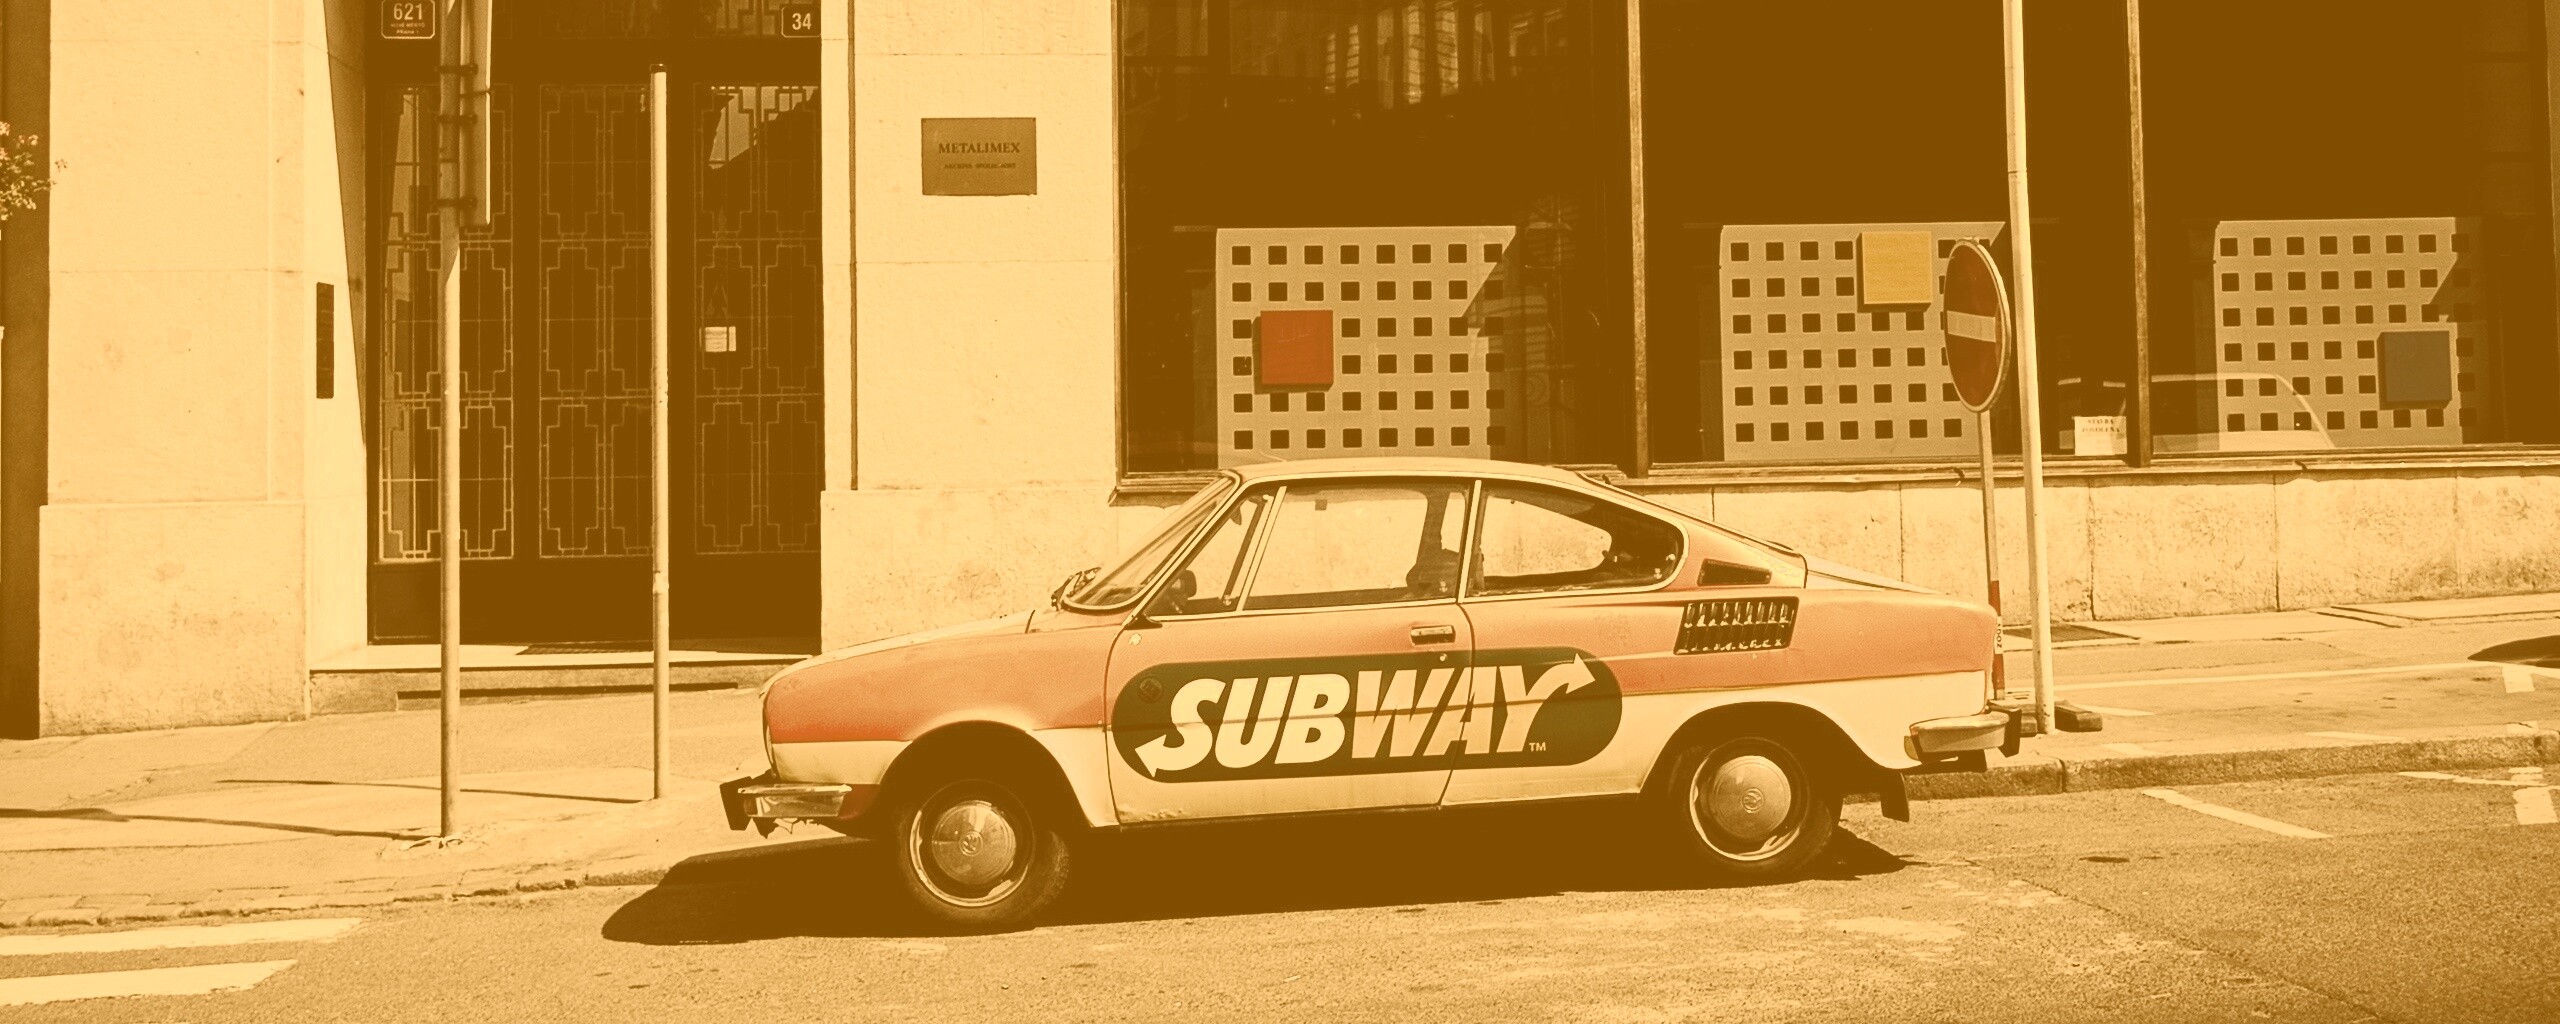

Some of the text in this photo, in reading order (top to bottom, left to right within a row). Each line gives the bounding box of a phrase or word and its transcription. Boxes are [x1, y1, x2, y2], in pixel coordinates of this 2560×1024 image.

[393, 2, 423, 20] 621
[792, 12, 811, 30] 34
[938, 142, 1020, 154] METALIMEX
[1134, 653, 1595, 778] SUBWAY
[1529, 741, 1546, 752] TM
